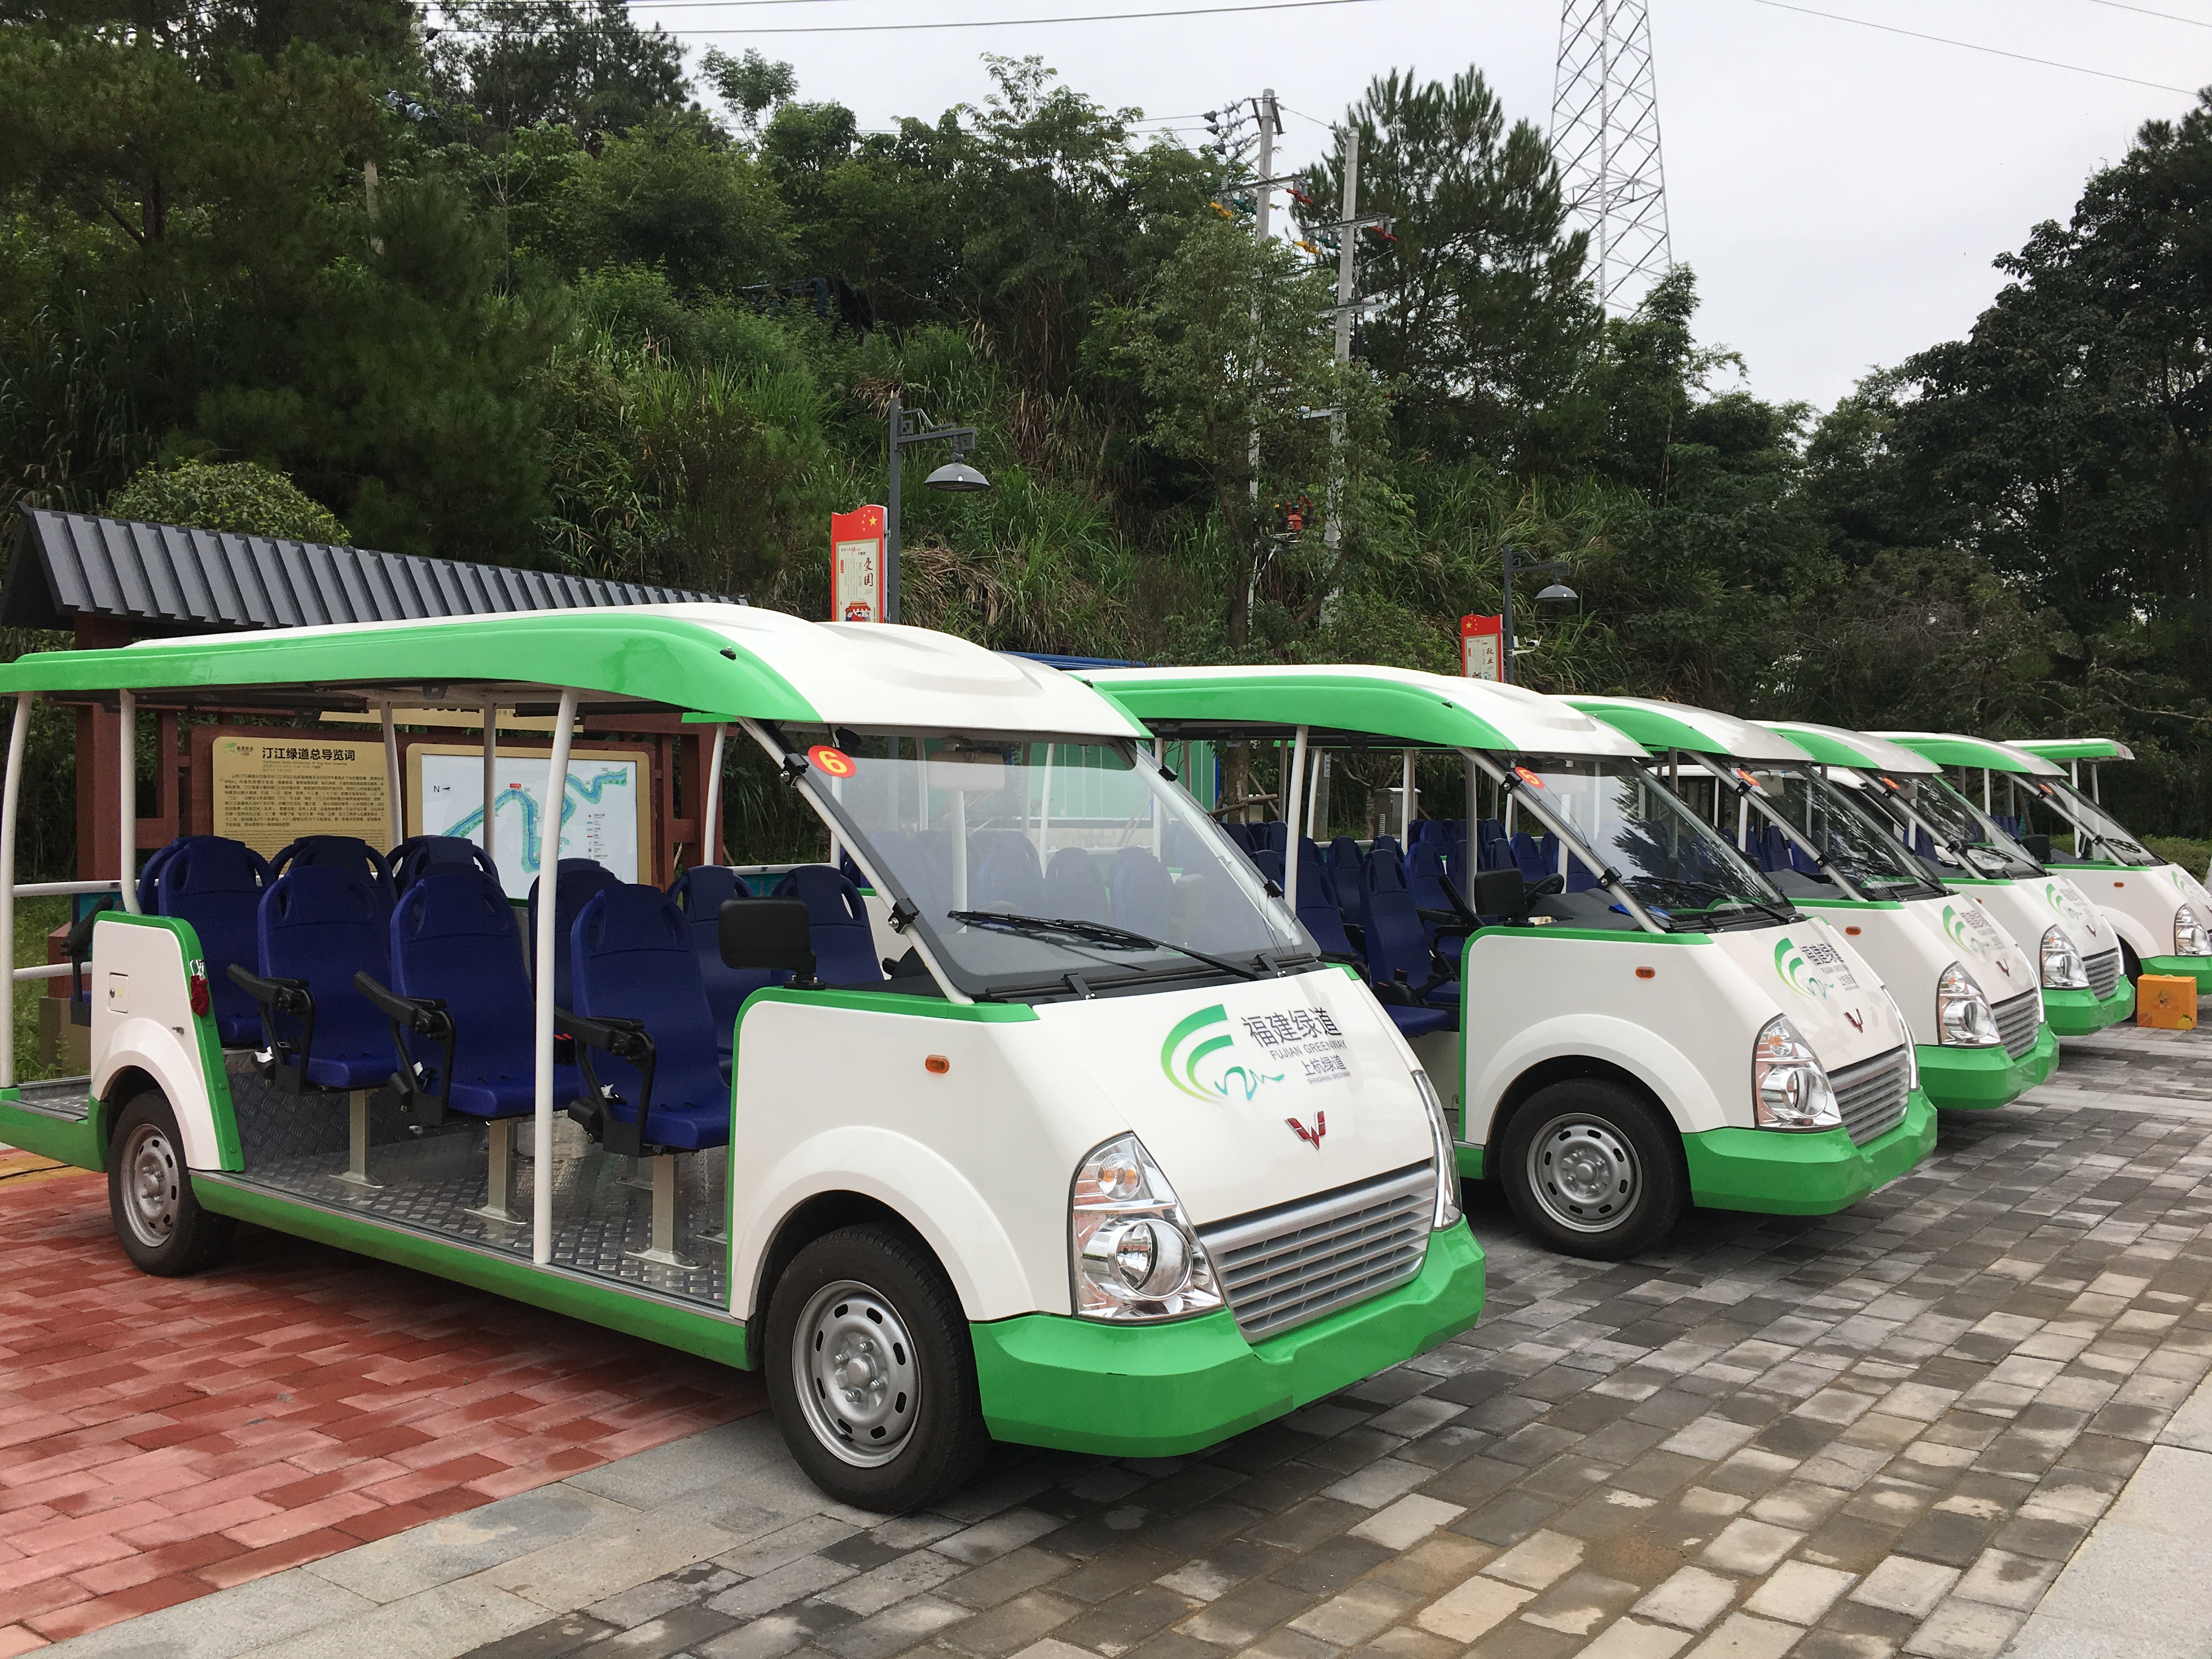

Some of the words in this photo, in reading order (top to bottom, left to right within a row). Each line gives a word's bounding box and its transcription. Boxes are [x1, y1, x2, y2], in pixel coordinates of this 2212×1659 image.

[262, 747, 356, 761] 汀江绿道总导览词
[819, 751, 848, 774] 6
[1518, 769, 1539, 785] 5
[1241, 1007, 1342, 1048] 福建绿道
[1269, 1045, 1302, 1060] FUJIAN
[1304, 1039, 1348, 1054] GREENWAY
[1301, 1054, 1347, 1076] 上杭绿道
